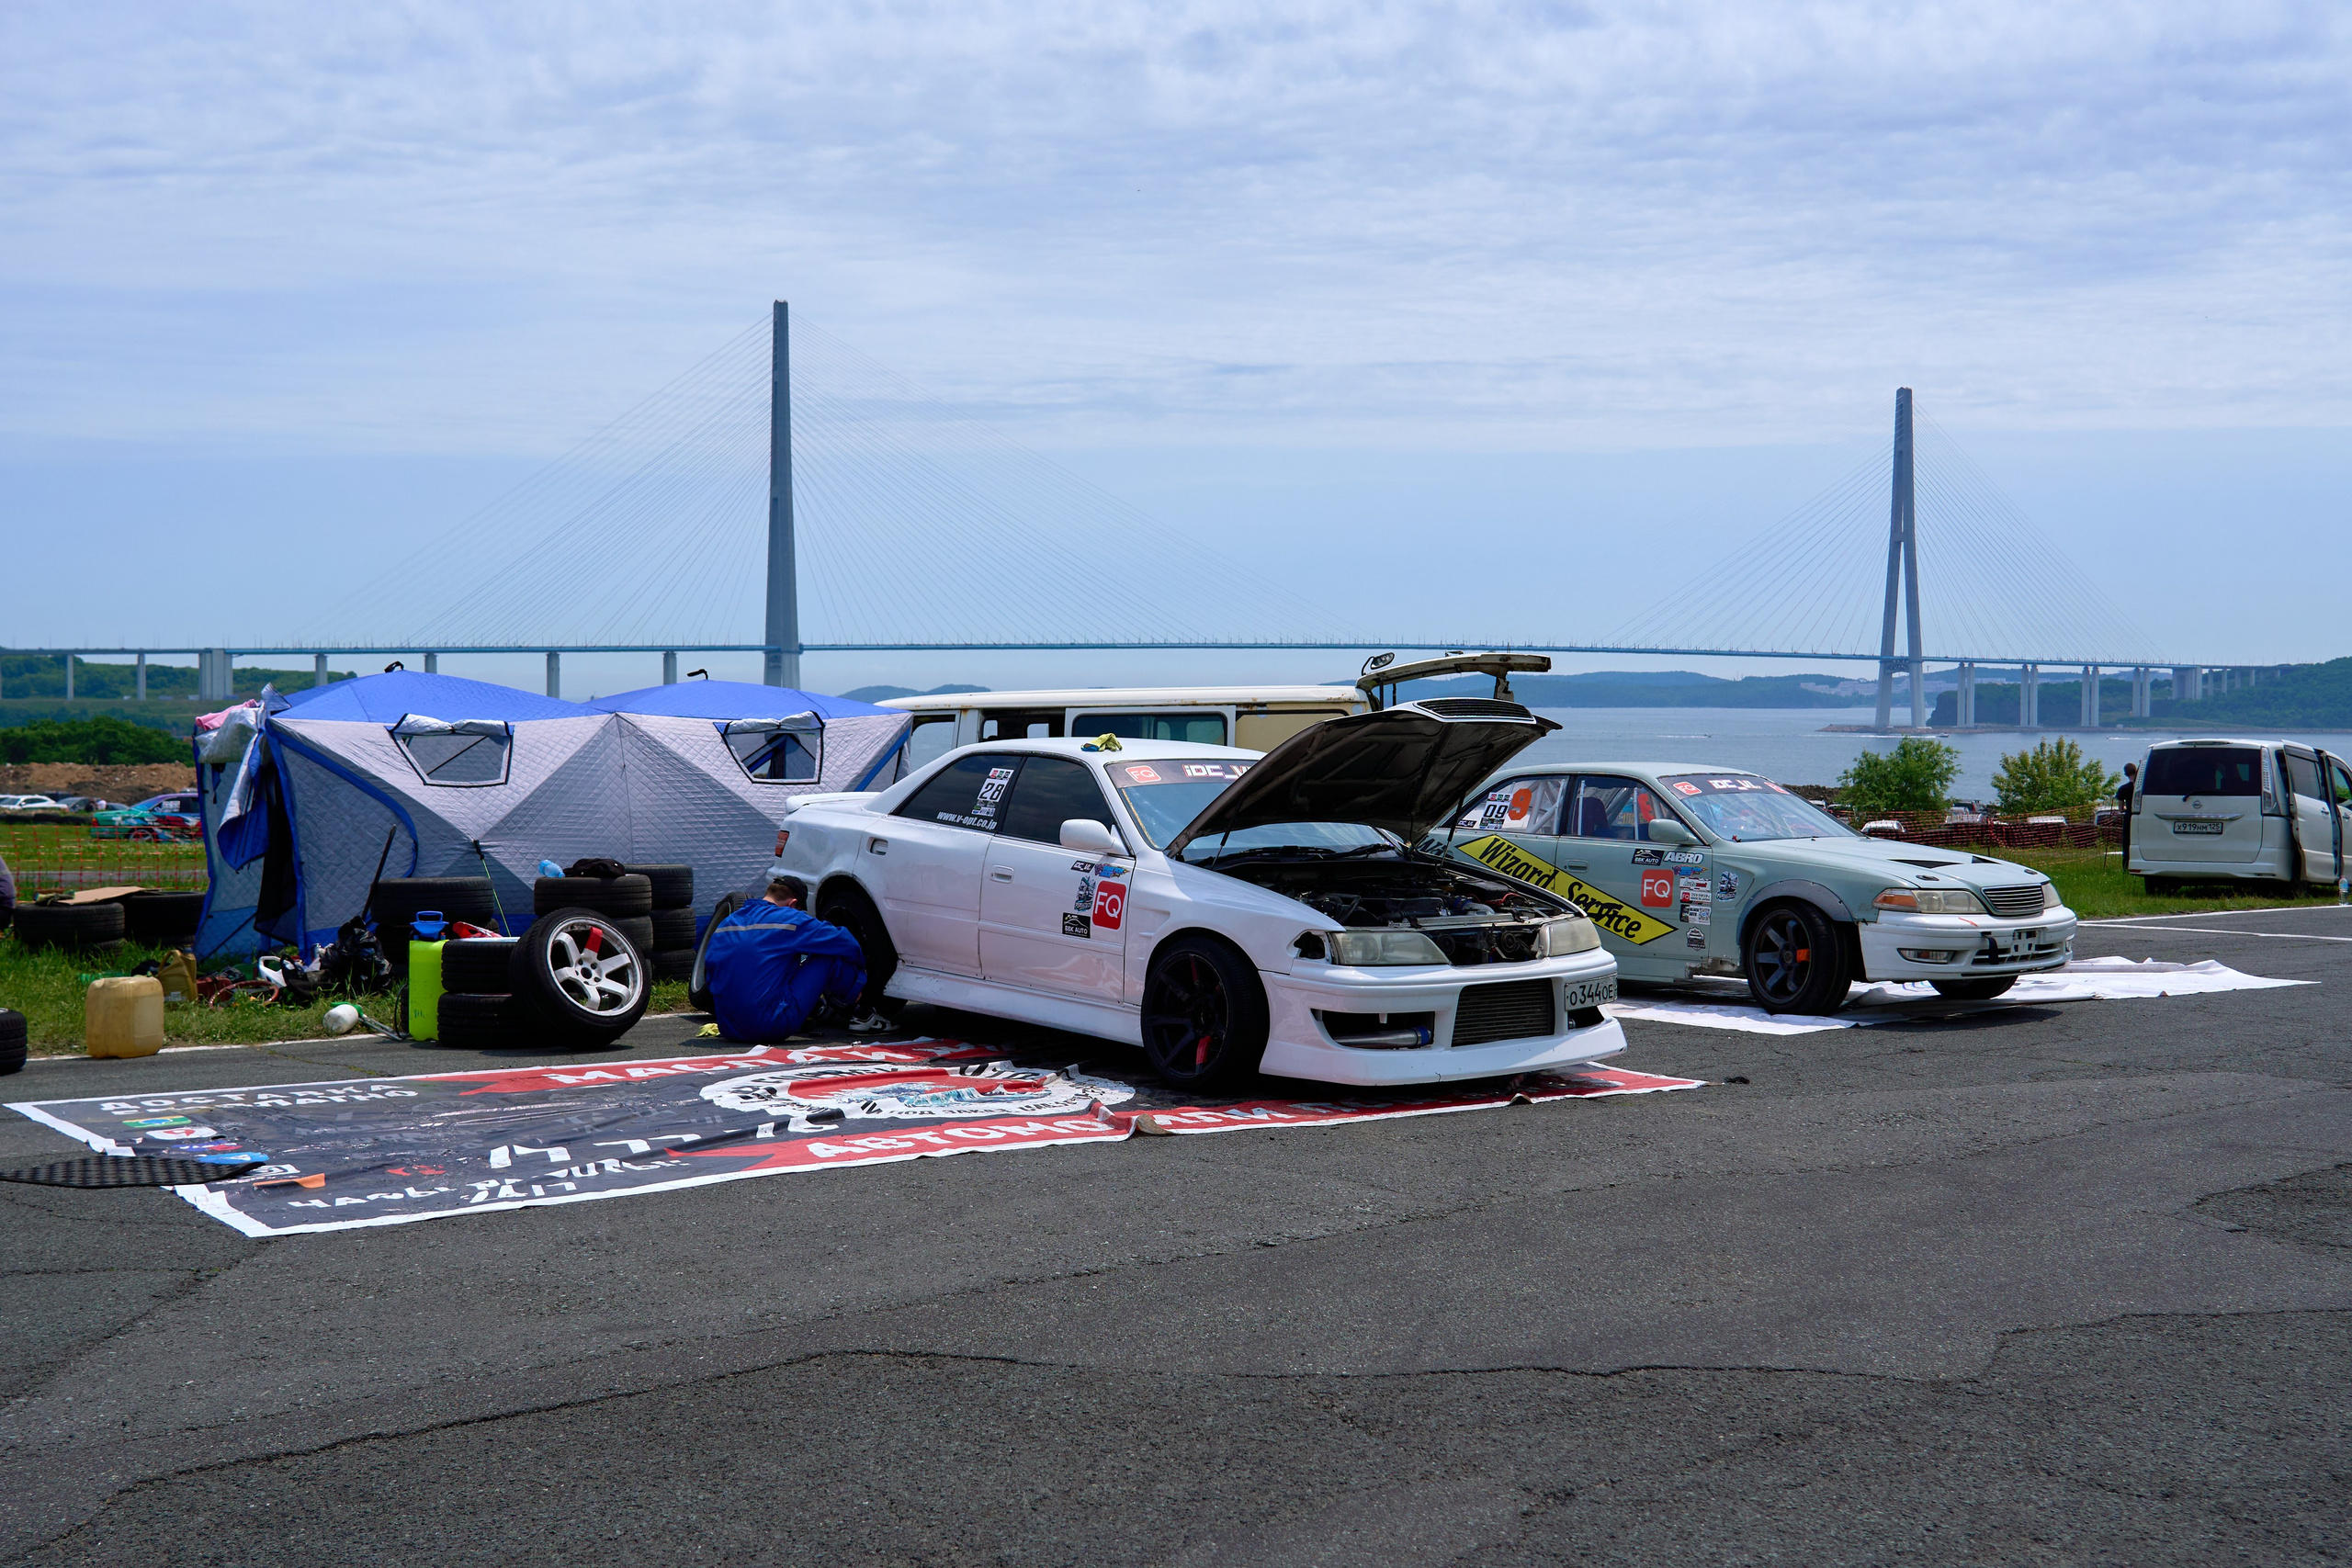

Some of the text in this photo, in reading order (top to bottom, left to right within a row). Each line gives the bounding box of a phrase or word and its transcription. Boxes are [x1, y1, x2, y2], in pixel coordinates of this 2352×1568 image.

[1130, 769, 1155, 780] FQ
[978, 782, 1005, 801] 28
[1483, 804, 1509, 818] 09
[1508, 788, 1532, 820] 9
[936, 811, 998, 830] www.v-opt.co.jp
[1477, 837, 1560, 890] Wizard
[1663, 851, 1704, 864] ABRO
[1643, 878, 1670, 898] FQ
[1094, 891, 1122, 919] FQ
